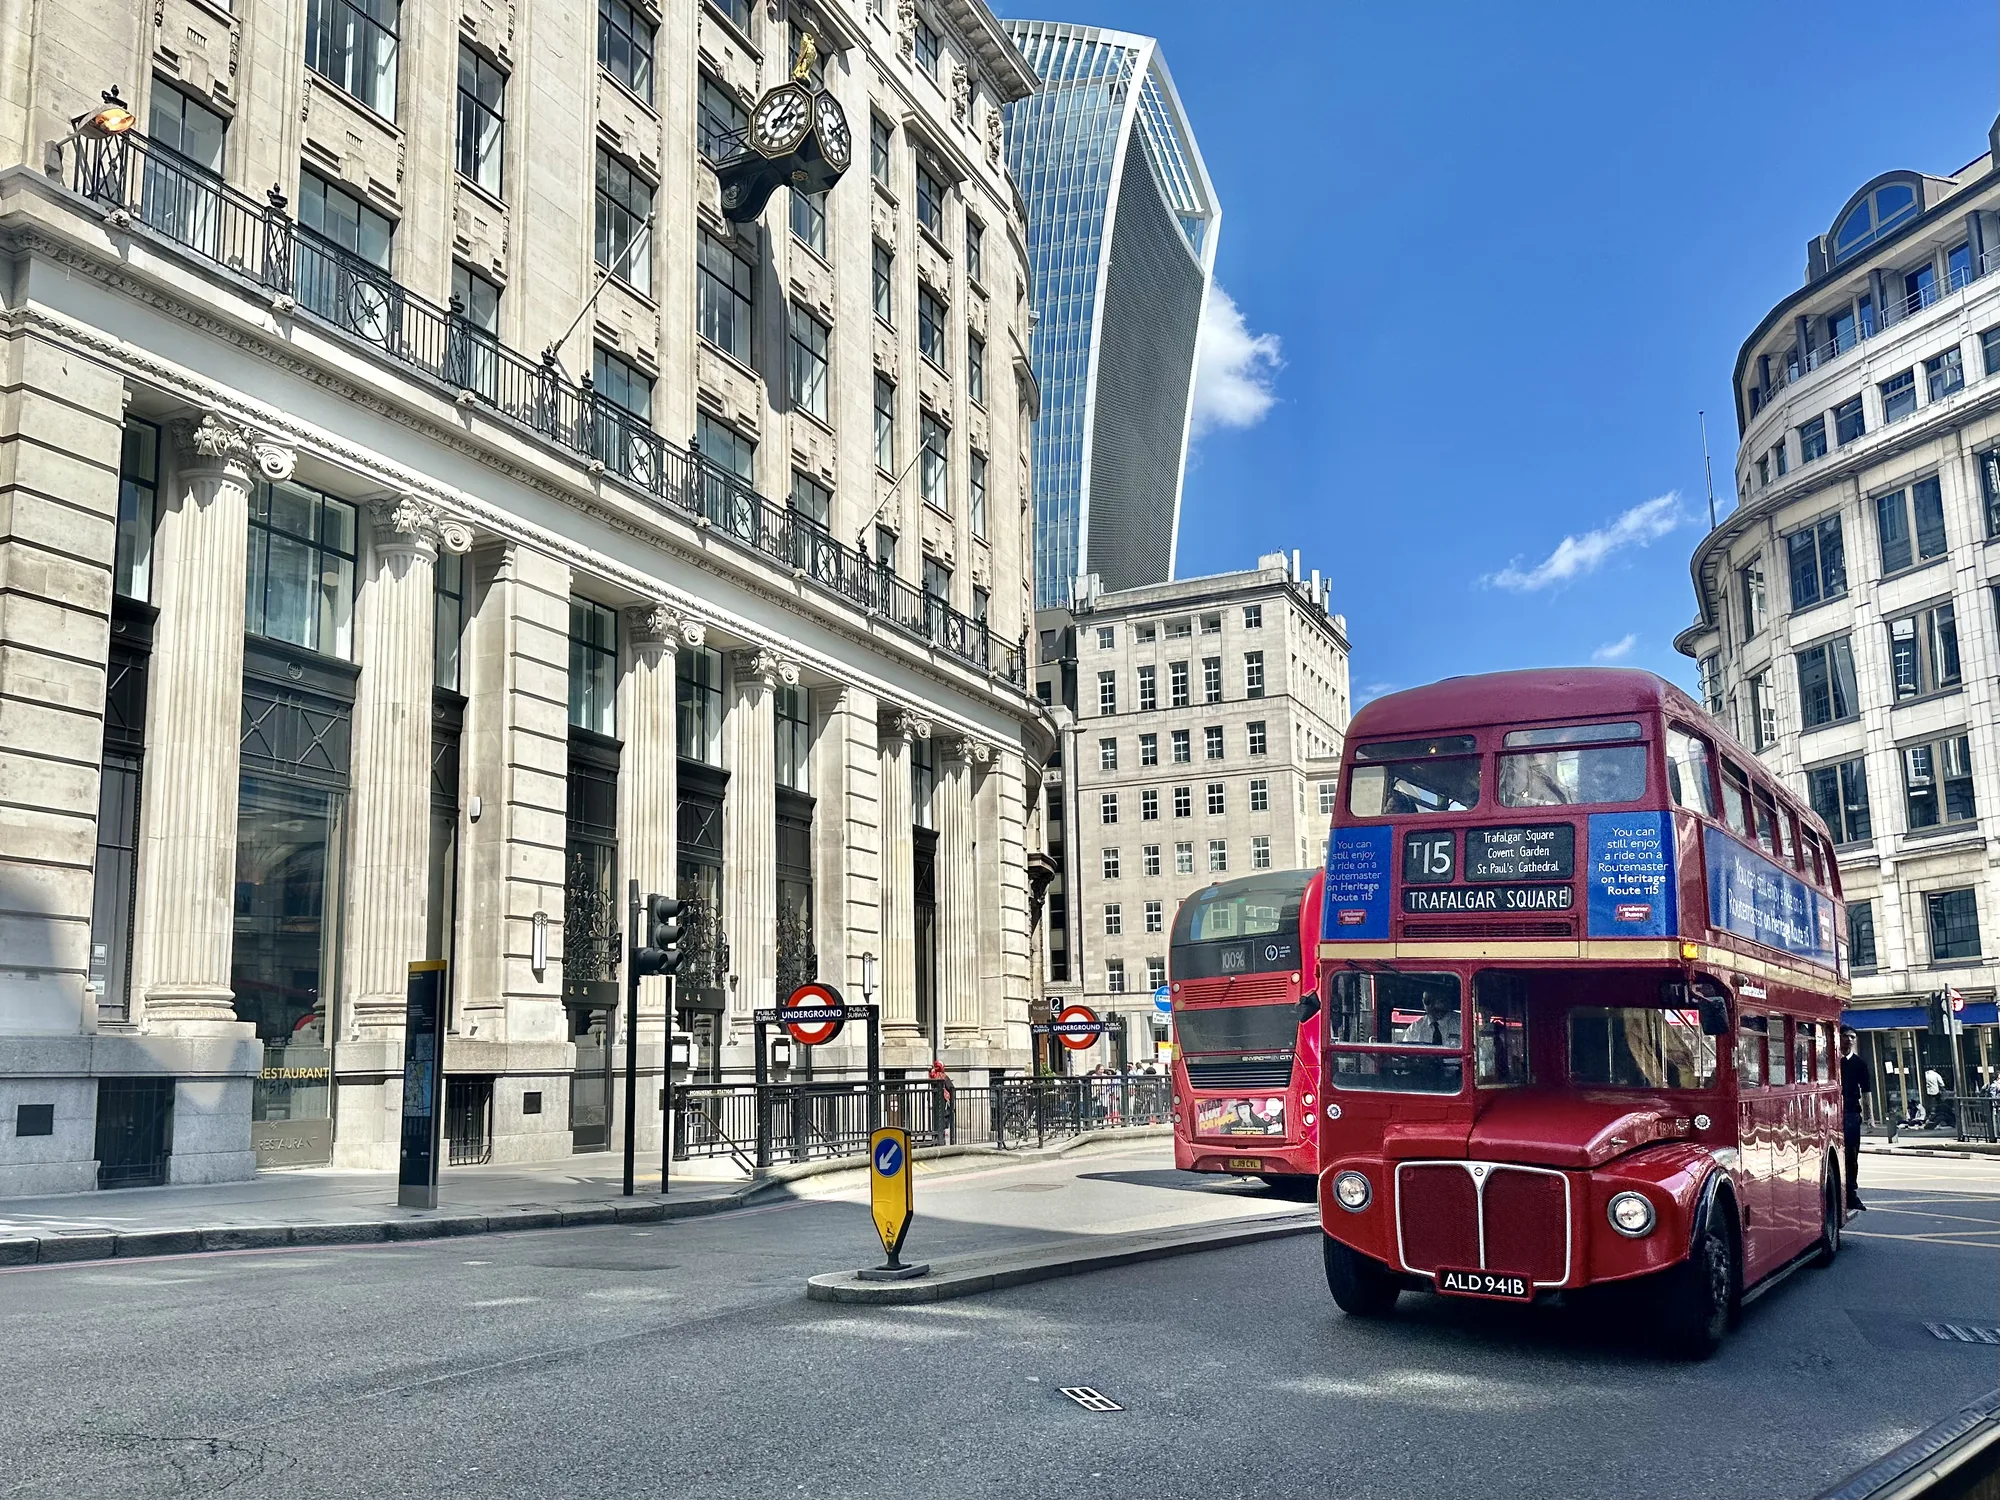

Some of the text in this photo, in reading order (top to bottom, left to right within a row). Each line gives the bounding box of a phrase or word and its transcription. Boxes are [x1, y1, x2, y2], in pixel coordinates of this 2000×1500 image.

[1484, 830, 1554, 844] Trafalgar Square
[1612, 828, 1655, 837] You can
[1337, 841, 1371, 849] You can
[1607, 839, 1660, 850] still enjoy
[1332, 851, 1375, 861] still enjoy
[1409, 841, 1451, 874] T15
[1488, 846, 1549, 859] Covent Garden
[1614, 851, 1635, 860] ride
[1337, 861, 1354, 870] ride
[1371, 861, 1377, 869] a
[1477, 860, 1559, 874] St Paul's Cathedral
[1598, 863, 1668, 872] Routemaster
[1325, 871, 1381, 881] Routemaster
[1618, 874, 1666, 885] Heritage
[1340, 882, 1379, 892] Heritage
[1607, 886, 1640, 895] Route
[1331, 893, 1358, 902] Route
[1410, 889, 1568, 909] TRAFALGAR SQUARE
[1222, 950, 1245, 969] 100%
[781, 1009, 842, 1019] UNDERGROUND
[1053, 1024, 1100, 1032] UNDERGROUND
[257, 1067, 329, 1079] RESTAURANT
[1444, 1273, 1525, 1295] ALD 941B
